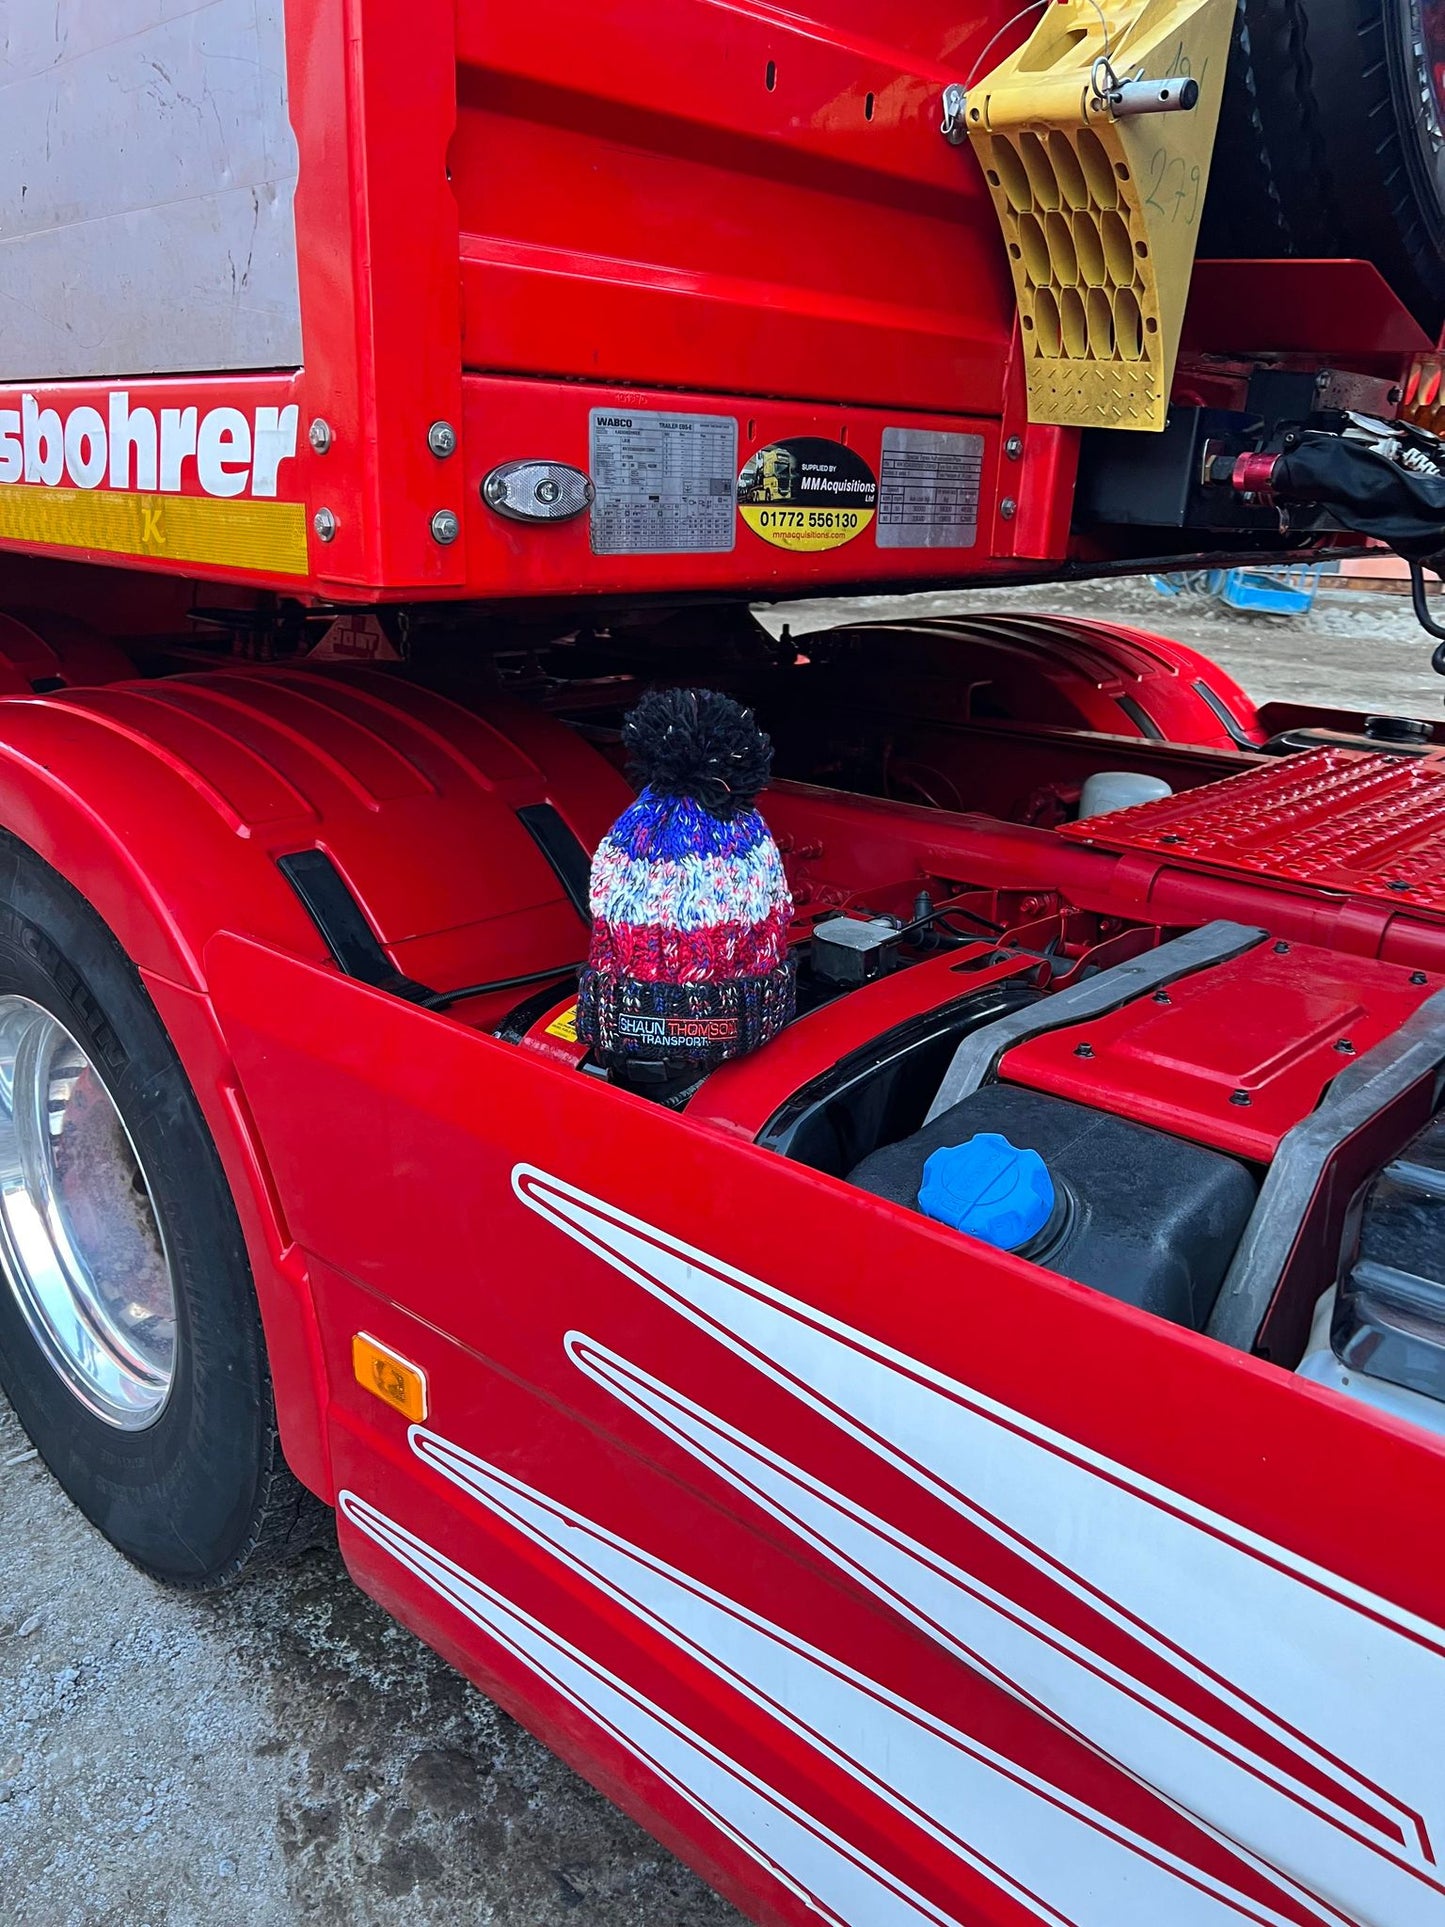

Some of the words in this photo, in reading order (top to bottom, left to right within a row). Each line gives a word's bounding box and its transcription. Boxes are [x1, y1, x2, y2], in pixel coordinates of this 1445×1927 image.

[1145, 146, 1201, 225] 279
[597, 417, 632, 428] WABCO
[0, 391, 299, 497] sbohrer
[801, 463, 829, 472] SUPPLIED
[865, 494, 874, 502] Ltd
[141, 508, 166, 544] K
[760, 511, 804, 527] 01772
[809, 512, 858, 528] 556130
[772, 531, 845, 540] mmacquisitions.com
[620, 1017, 665, 1035] SHAUN
[668, 1022, 737, 1037] THOMSON
[640, 1034, 709, 1046] TRANSPORT
